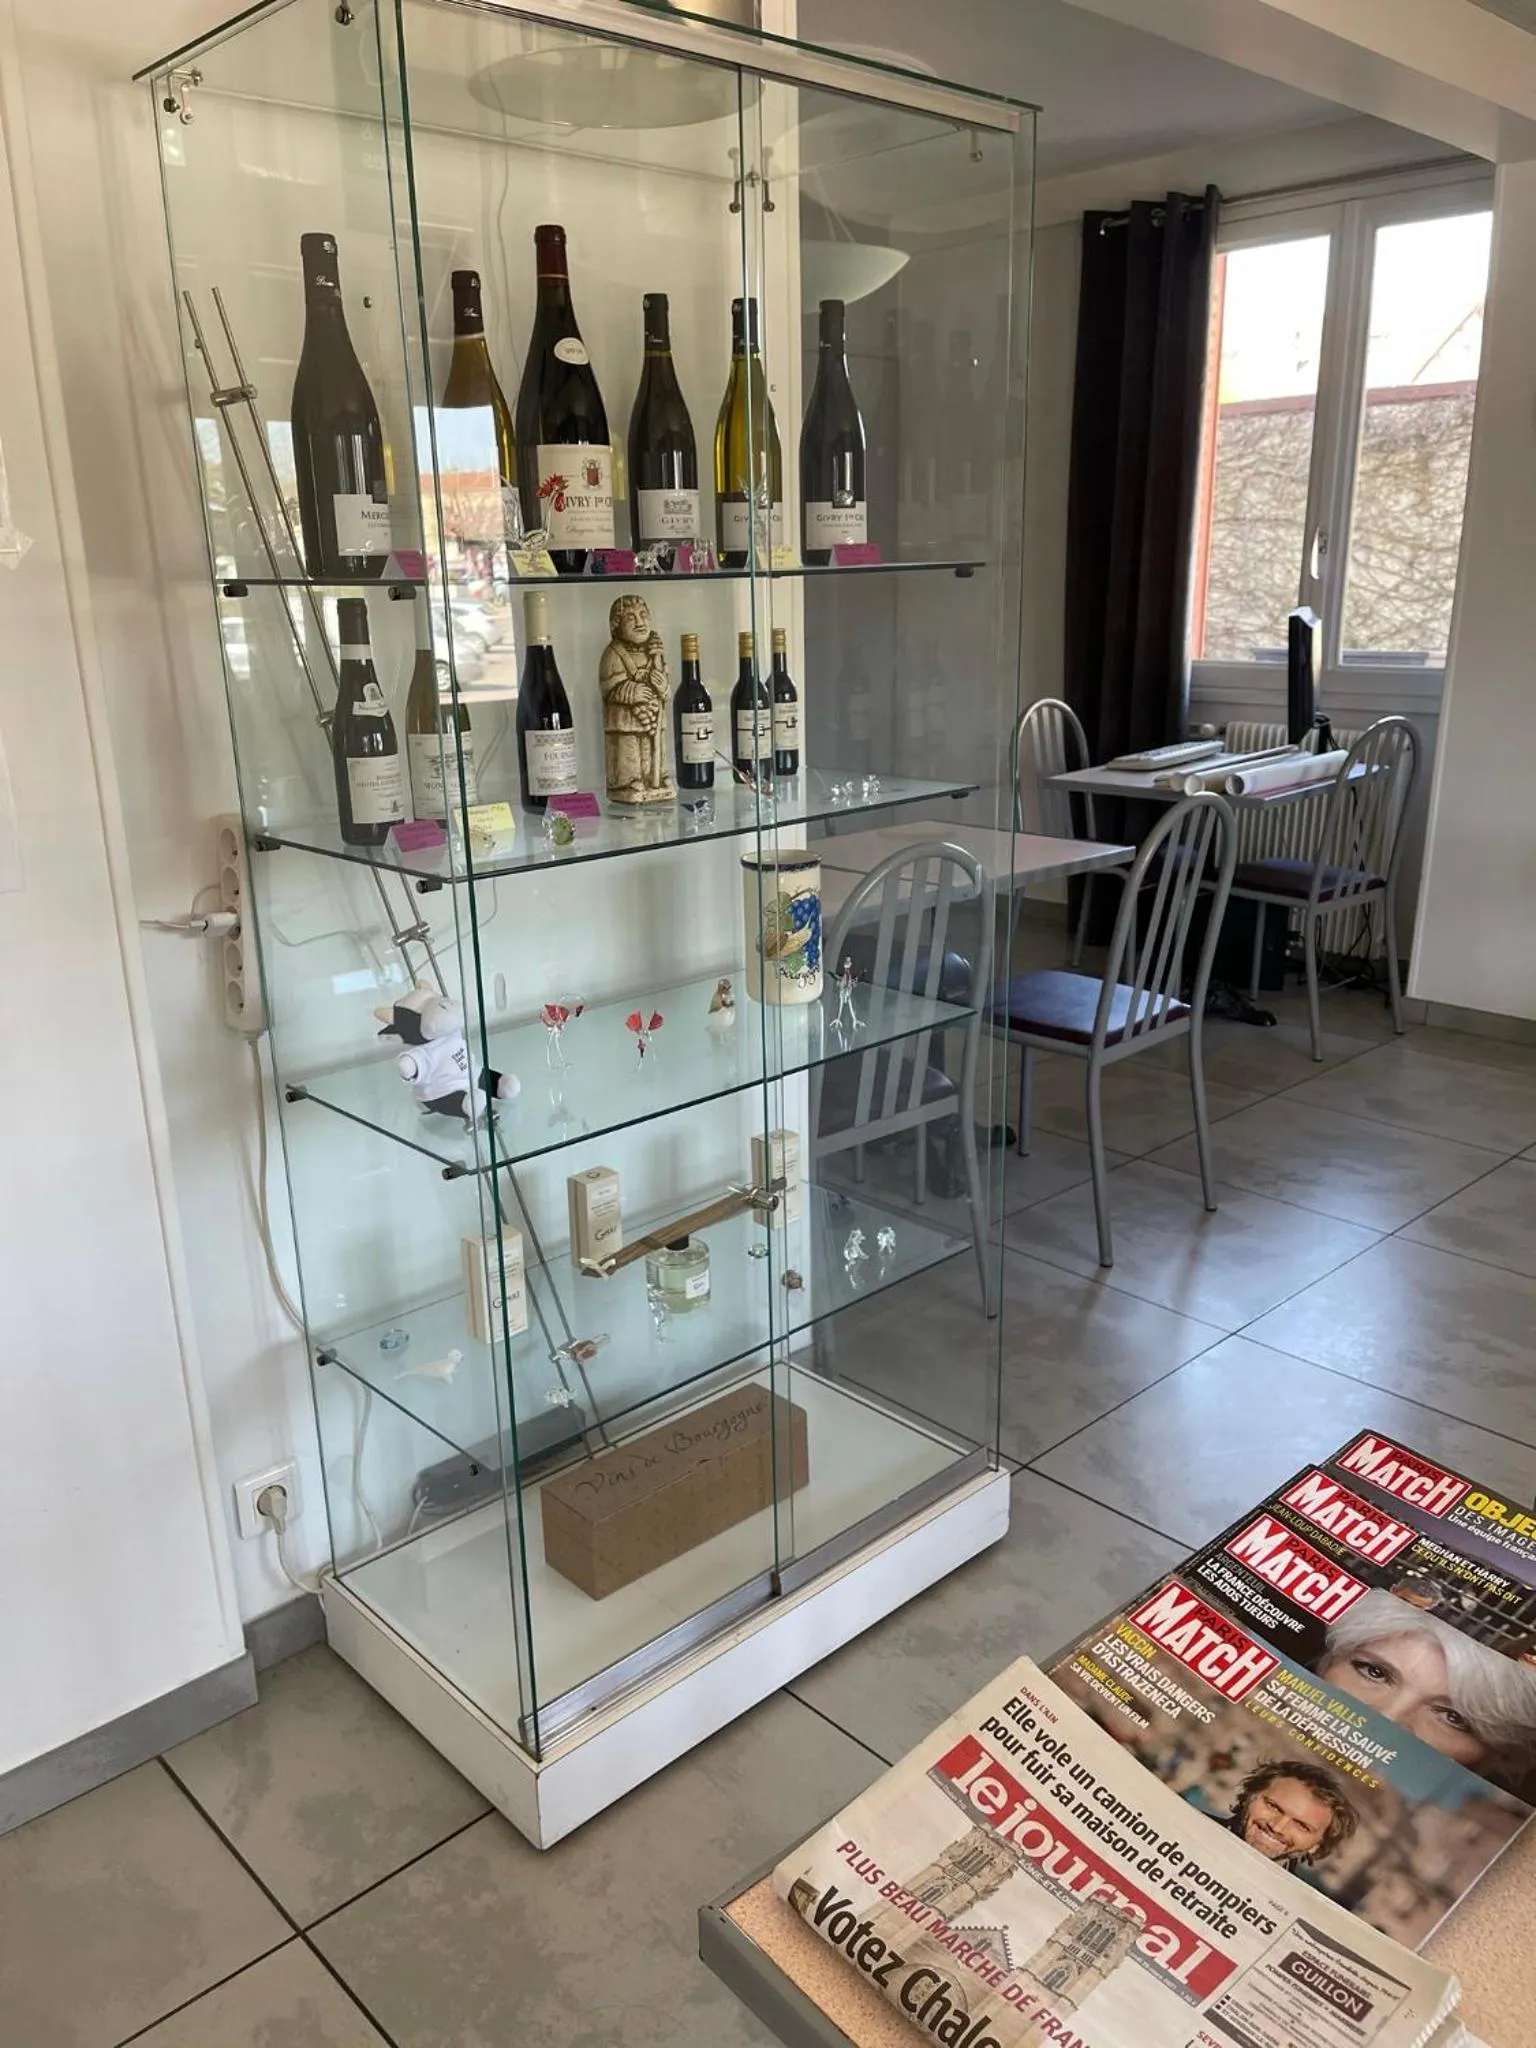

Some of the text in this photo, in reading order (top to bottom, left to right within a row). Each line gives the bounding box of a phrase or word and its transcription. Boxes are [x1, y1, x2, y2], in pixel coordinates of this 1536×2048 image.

[574, 1467, 634, 1495] Vins
[664, 1401, 765, 1454] Bourgogne
[1344, 1437, 1465, 1517] MATCH
[1289, 1475, 1411, 1563] MATCH
[1447, 1514, 1468, 1530] Une
[1467, 1524, 1502, 1545] équipe
[1454, 1506, 1485, 1525] DES
[1206, 1557, 1221, 1572] LA
[1217, 1567, 1256, 1599] FRANCE
[1251, 1594, 1305, 1634] DÉCOUVRE
[1232, 1519, 1363, 1620] MATCH
[1286, 1537, 1337, 1579] PARIS
[1460, 1557, 1476, 1571] ET
[1474, 1566, 1513, 1588] HARRY
[1195, 1606, 1247, 1650] PARIS
[1197, 1565, 1218, 1582] LES
[1213, 1579, 1242, 1602] ADOS
[1239, 1596, 1280, 1630] TUEURS
[1076, 1655, 1135, 1704] MADAME CLAUDE
[1091, 1642, 1183, 1719] D'ASTRAZENECA
[1103, 1633, 1216, 1725] LES VRAIS DANGERS
[1115, 1623, 1158, 1662] VACCIN
[1136, 1586, 1274, 1698] MATCH
[1019, 1686, 1041, 1706] DANS
[1070, 1661, 1150, 1730] SA VIE DEVIENT UN FILM
[1254, 1689, 1373, 1769] DE LA DÉPRESSION
[1266, 1679, 1287, 1700] SA
[1283, 1691, 1332, 1727] FEMME
[1348, 1731, 1398, 1765] SAUVÉ
[1276, 1669, 1367, 1728] MANUEL VALLS
[951, 1751, 1009, 1815] le
[1245, 1700, 1380, 1789] LEURS CONFIDENCES
[979, 1716, 1238, 1940] pour fuir sa maison de retraite
[1002, 1696, 1278, 1936] Elle vole un camion de pompiers
[813, 1885, 906, 1989] Votez
[836, 1839, 886, 1885] PLUS
[878, 1880, 932, 1924] BEAU
[1001, 1982, 1036, 2013] DE
[1290, 1960, 1364, 2015] GUILLON
